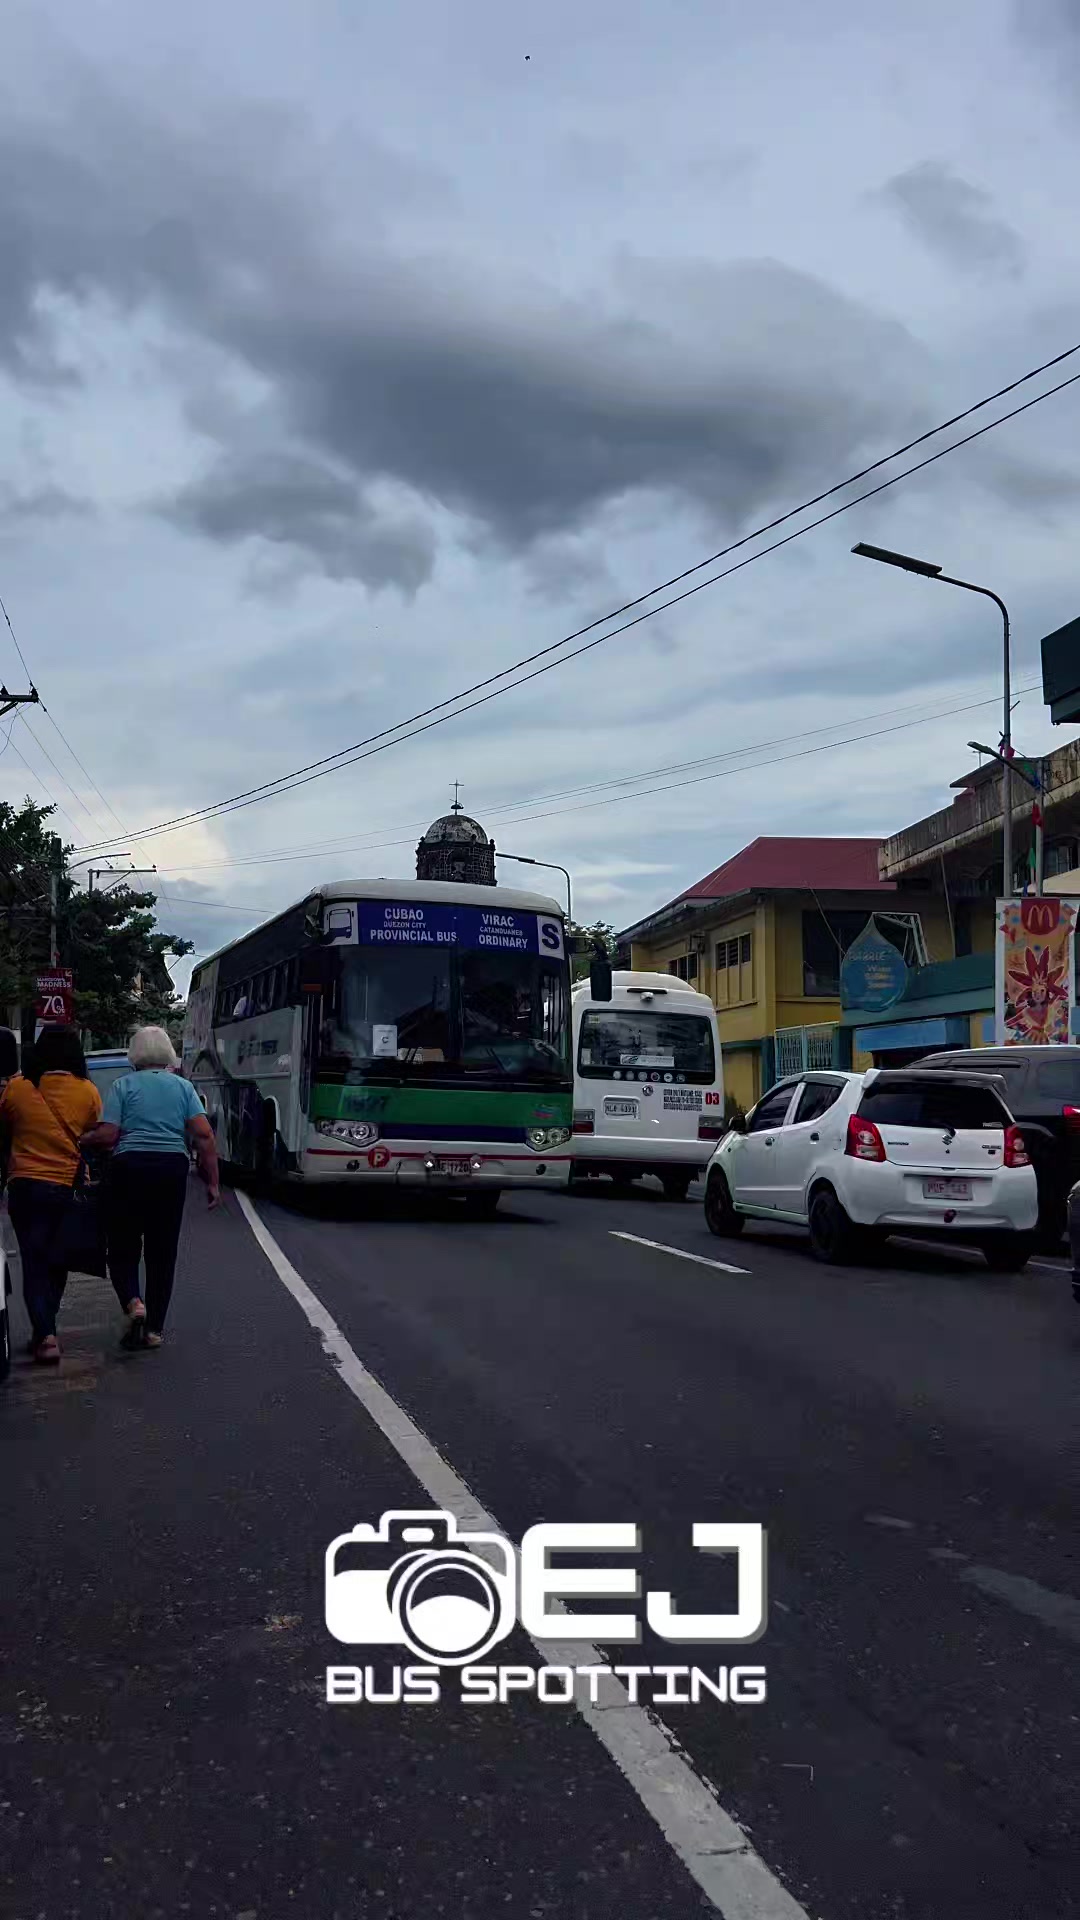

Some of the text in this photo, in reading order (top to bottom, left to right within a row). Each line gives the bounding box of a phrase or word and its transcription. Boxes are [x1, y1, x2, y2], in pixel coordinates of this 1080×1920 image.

[384, 908, 424, 920] CUBAO
[482, 913, 515, 927] VIRAC
[370, 929, 457, 943] PROVINCIAL BUS
[478, 935, 528, 949] ORDINARY
[541, 923, 561, 950] S
[374, 1152, 385, 1166] P
